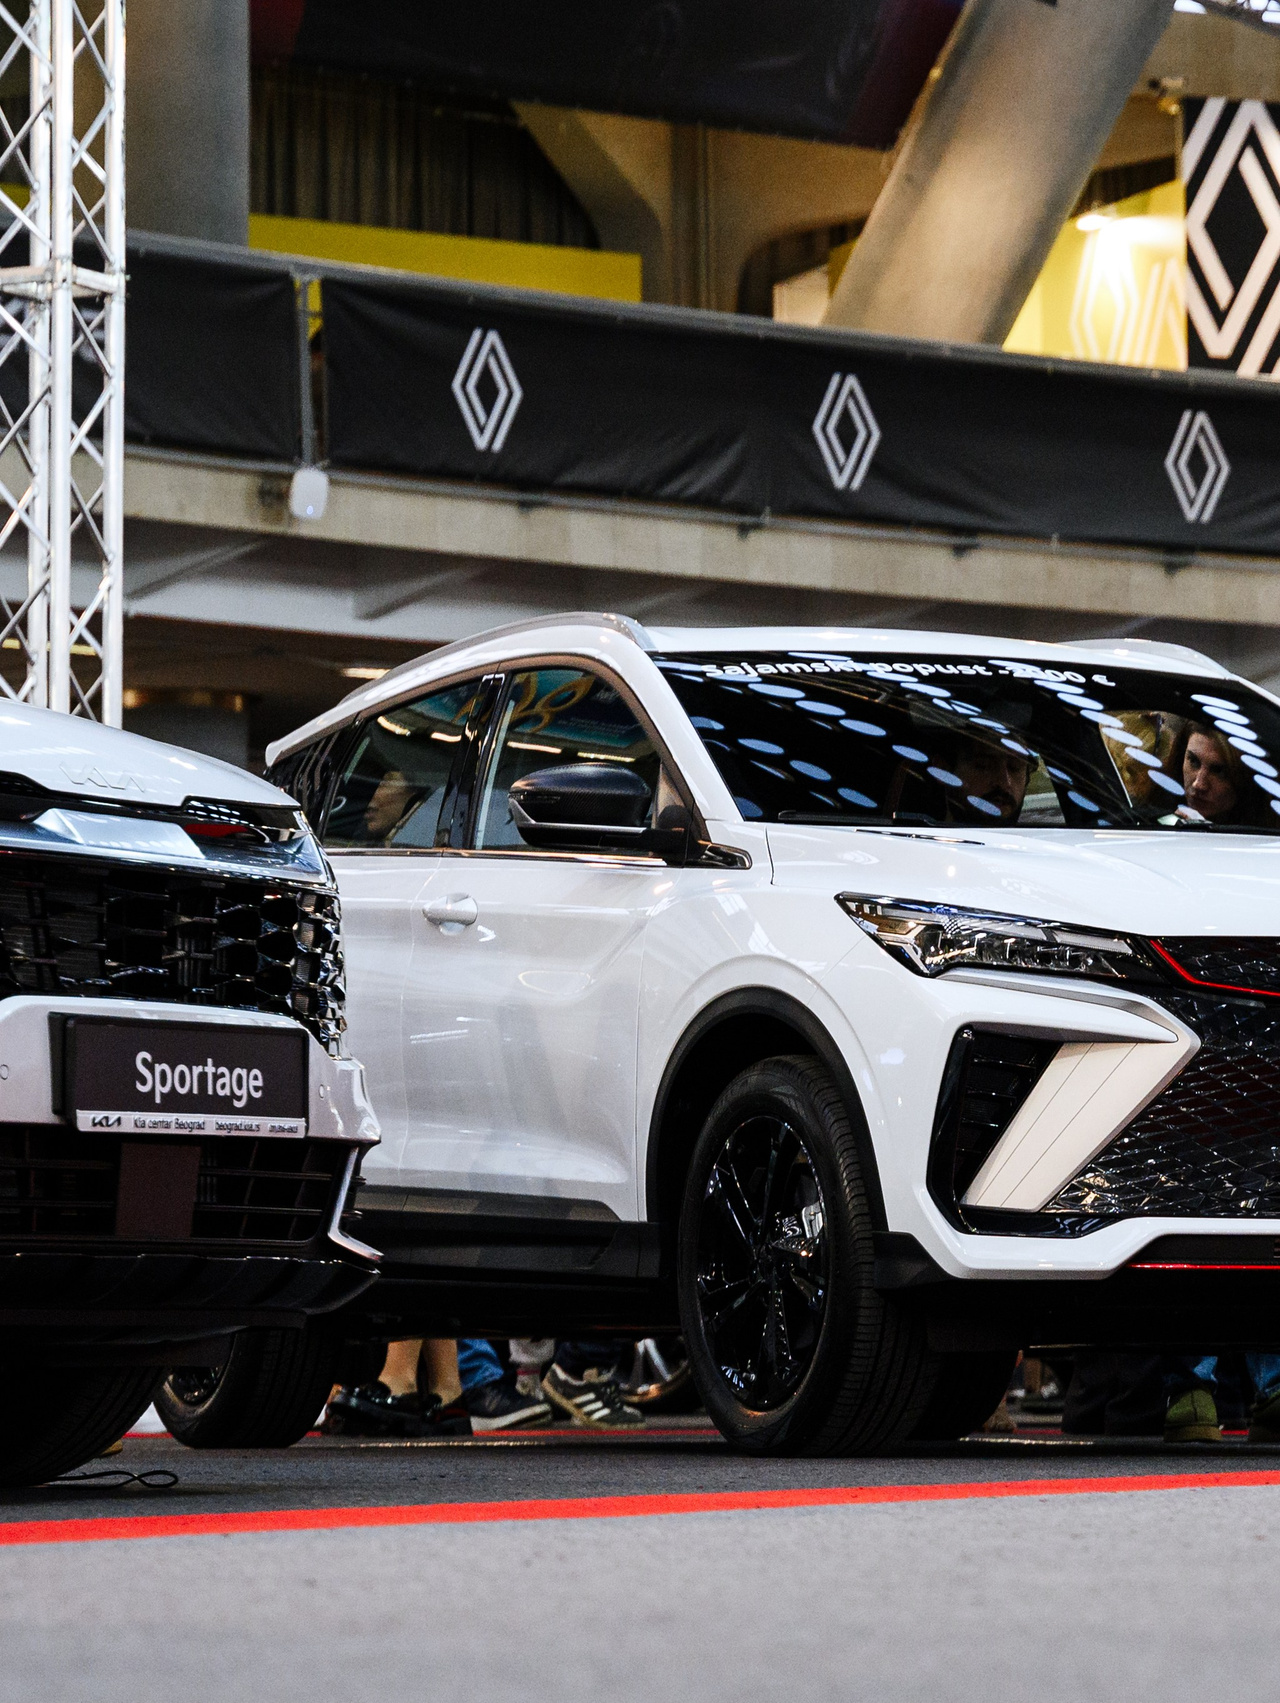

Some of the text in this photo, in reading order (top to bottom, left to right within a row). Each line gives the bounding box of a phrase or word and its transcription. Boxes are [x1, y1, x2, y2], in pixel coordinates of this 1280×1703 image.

[700, 660, 863, 678] Sajamski
[868, 662, 993, 676] popust
[135, 1051, 264, 1108] Sportage
[174, 1118, 205, 1132] Beograd
